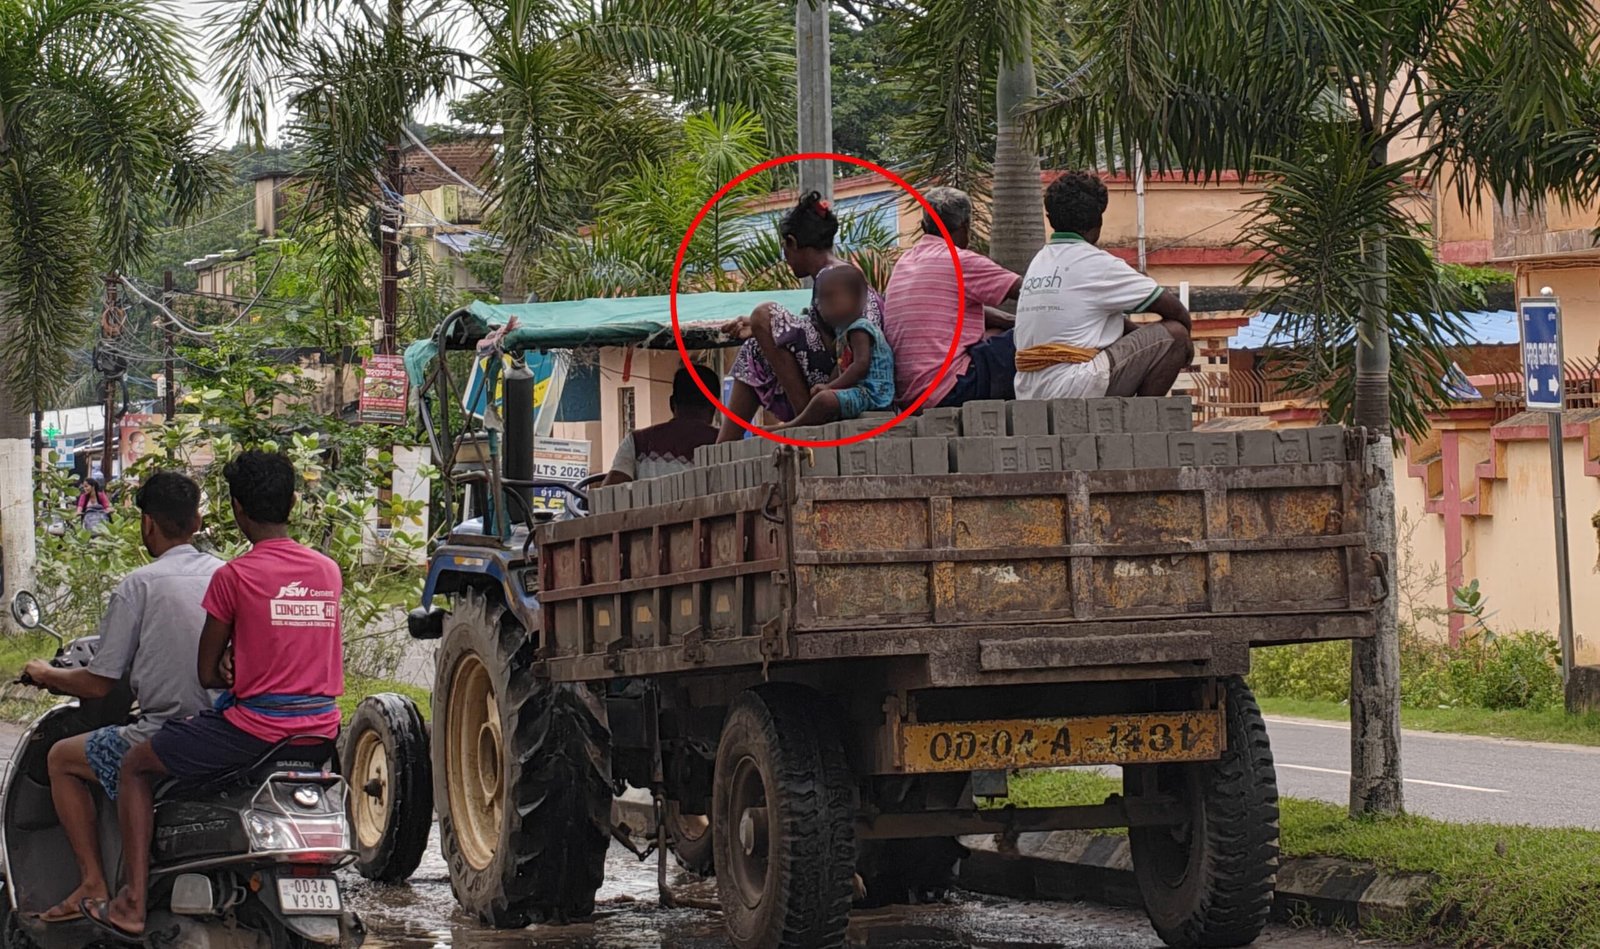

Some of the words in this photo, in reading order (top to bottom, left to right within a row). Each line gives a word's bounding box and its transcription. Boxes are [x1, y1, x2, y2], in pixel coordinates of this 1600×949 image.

[560, 466, 586, 478] 2026
[275, 583, 308, 599] JSW
[310, 589, 334, 598] Cement
[275, 603, 319, 617] CONCREEL
[276, 760, 315, 769] SUZUKI
[294, 879, 328, 894] OD34
[292, 894, 333, 909] V3193
